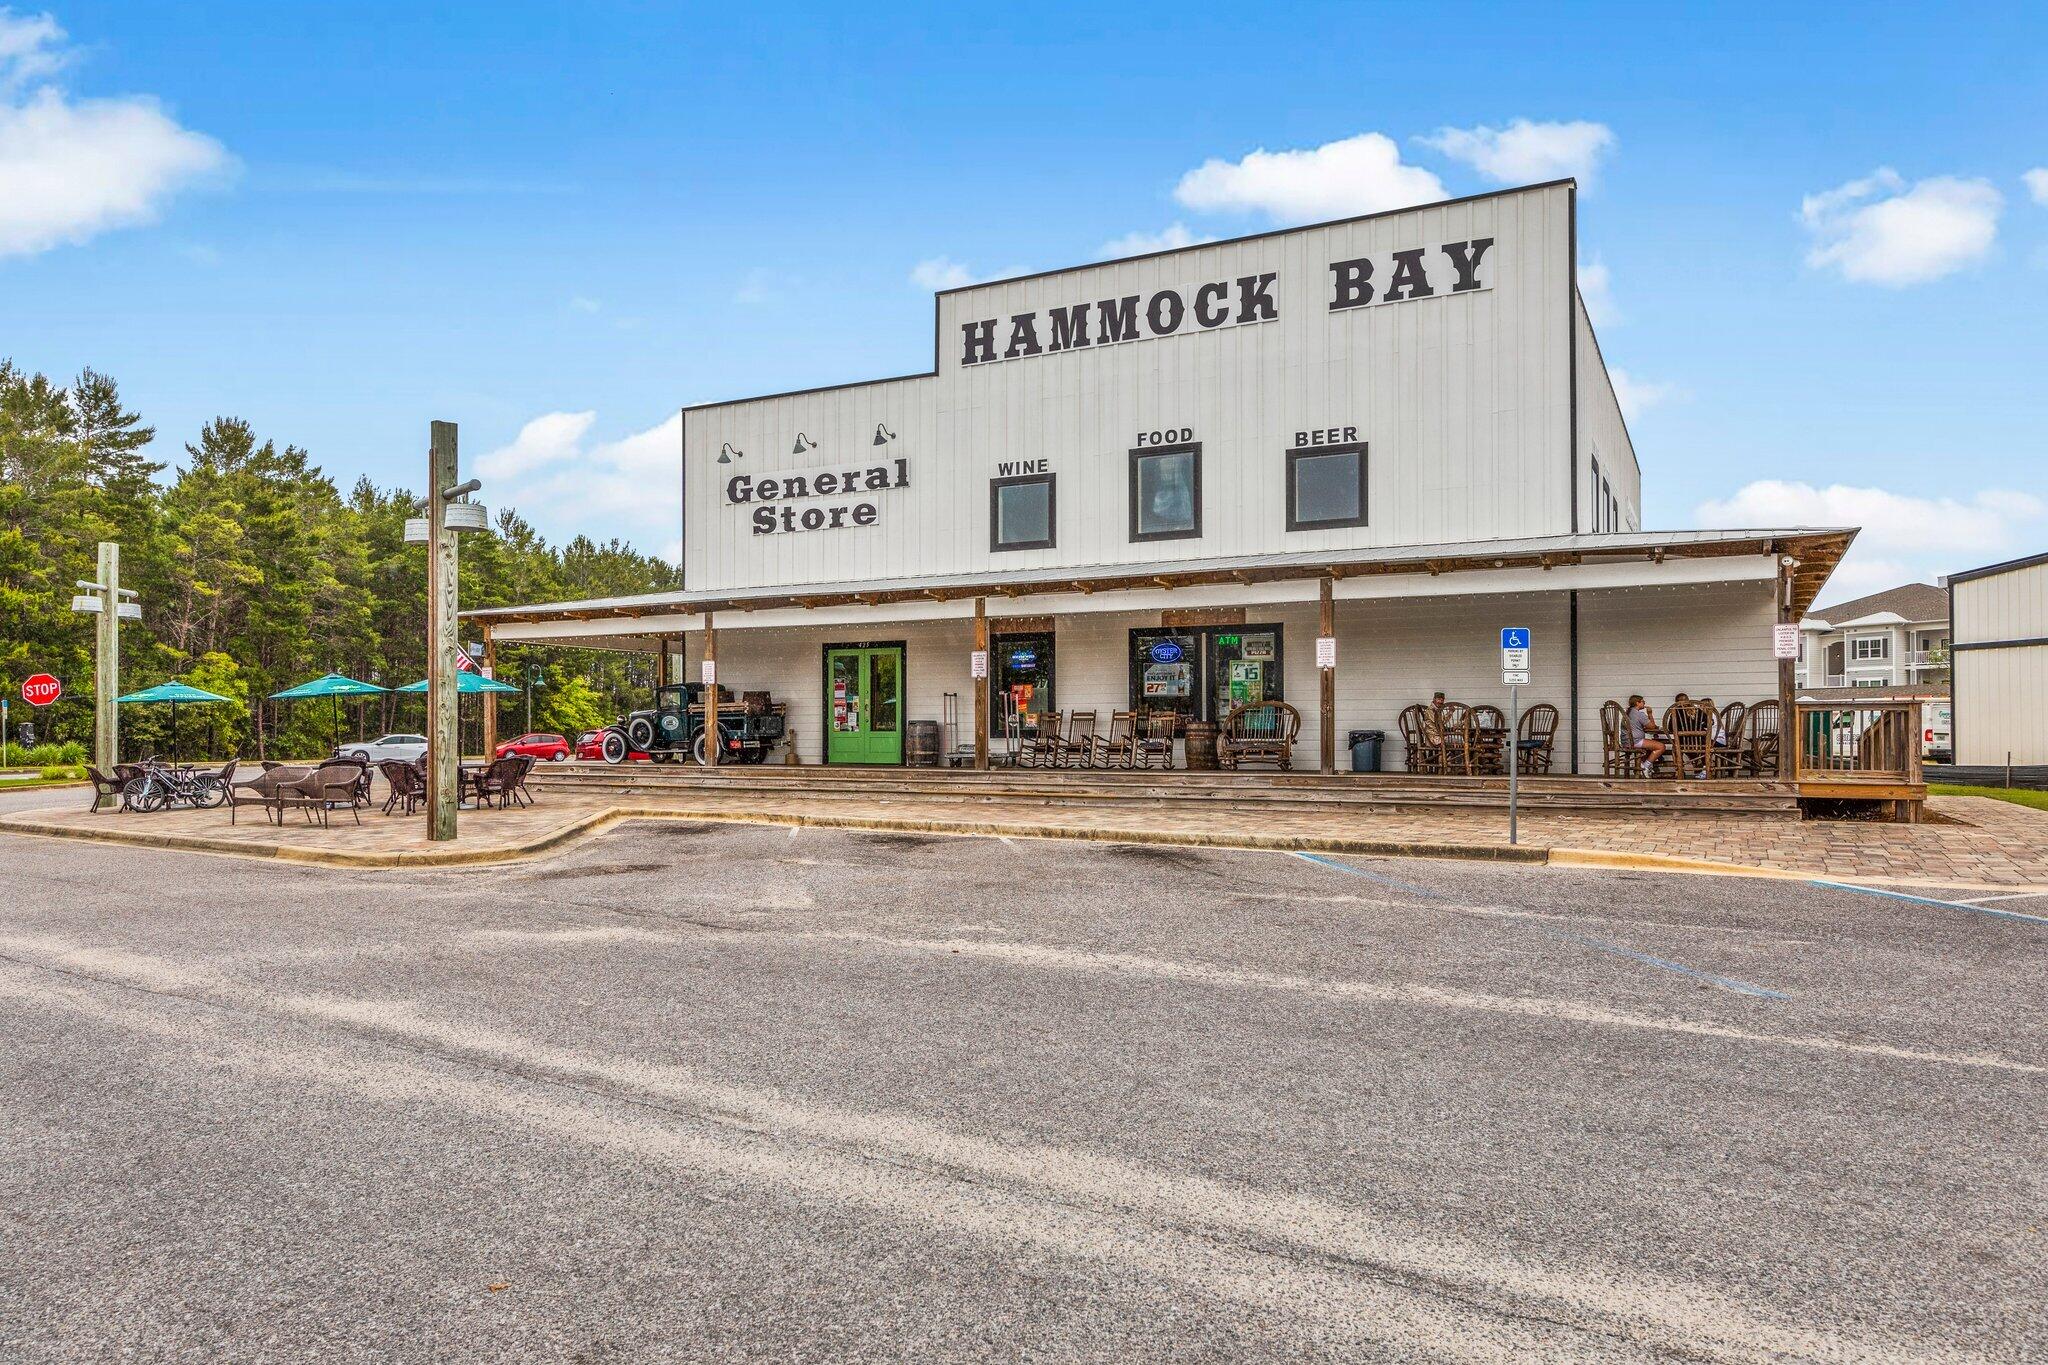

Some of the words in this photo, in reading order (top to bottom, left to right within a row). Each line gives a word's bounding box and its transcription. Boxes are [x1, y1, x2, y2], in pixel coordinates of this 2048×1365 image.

[961, 272, 1278, 365] HAMMOCK
[1328, 237, 1494, 311] BAY
[1136, 427, 1194, 447] FOOD
[1294, 426, 1359, 447] BEER
[998, 458, 1049, 476] WINE
[726, 458, 910, 503] General
[752, 503, 877, 535] Store
[1218, 636, 1239, 645] ATM
[1154, 647, 1178, 655] OYSTER
[1243, 667, 1259, 680] 15
[26, 683, 57, 697] STOP
